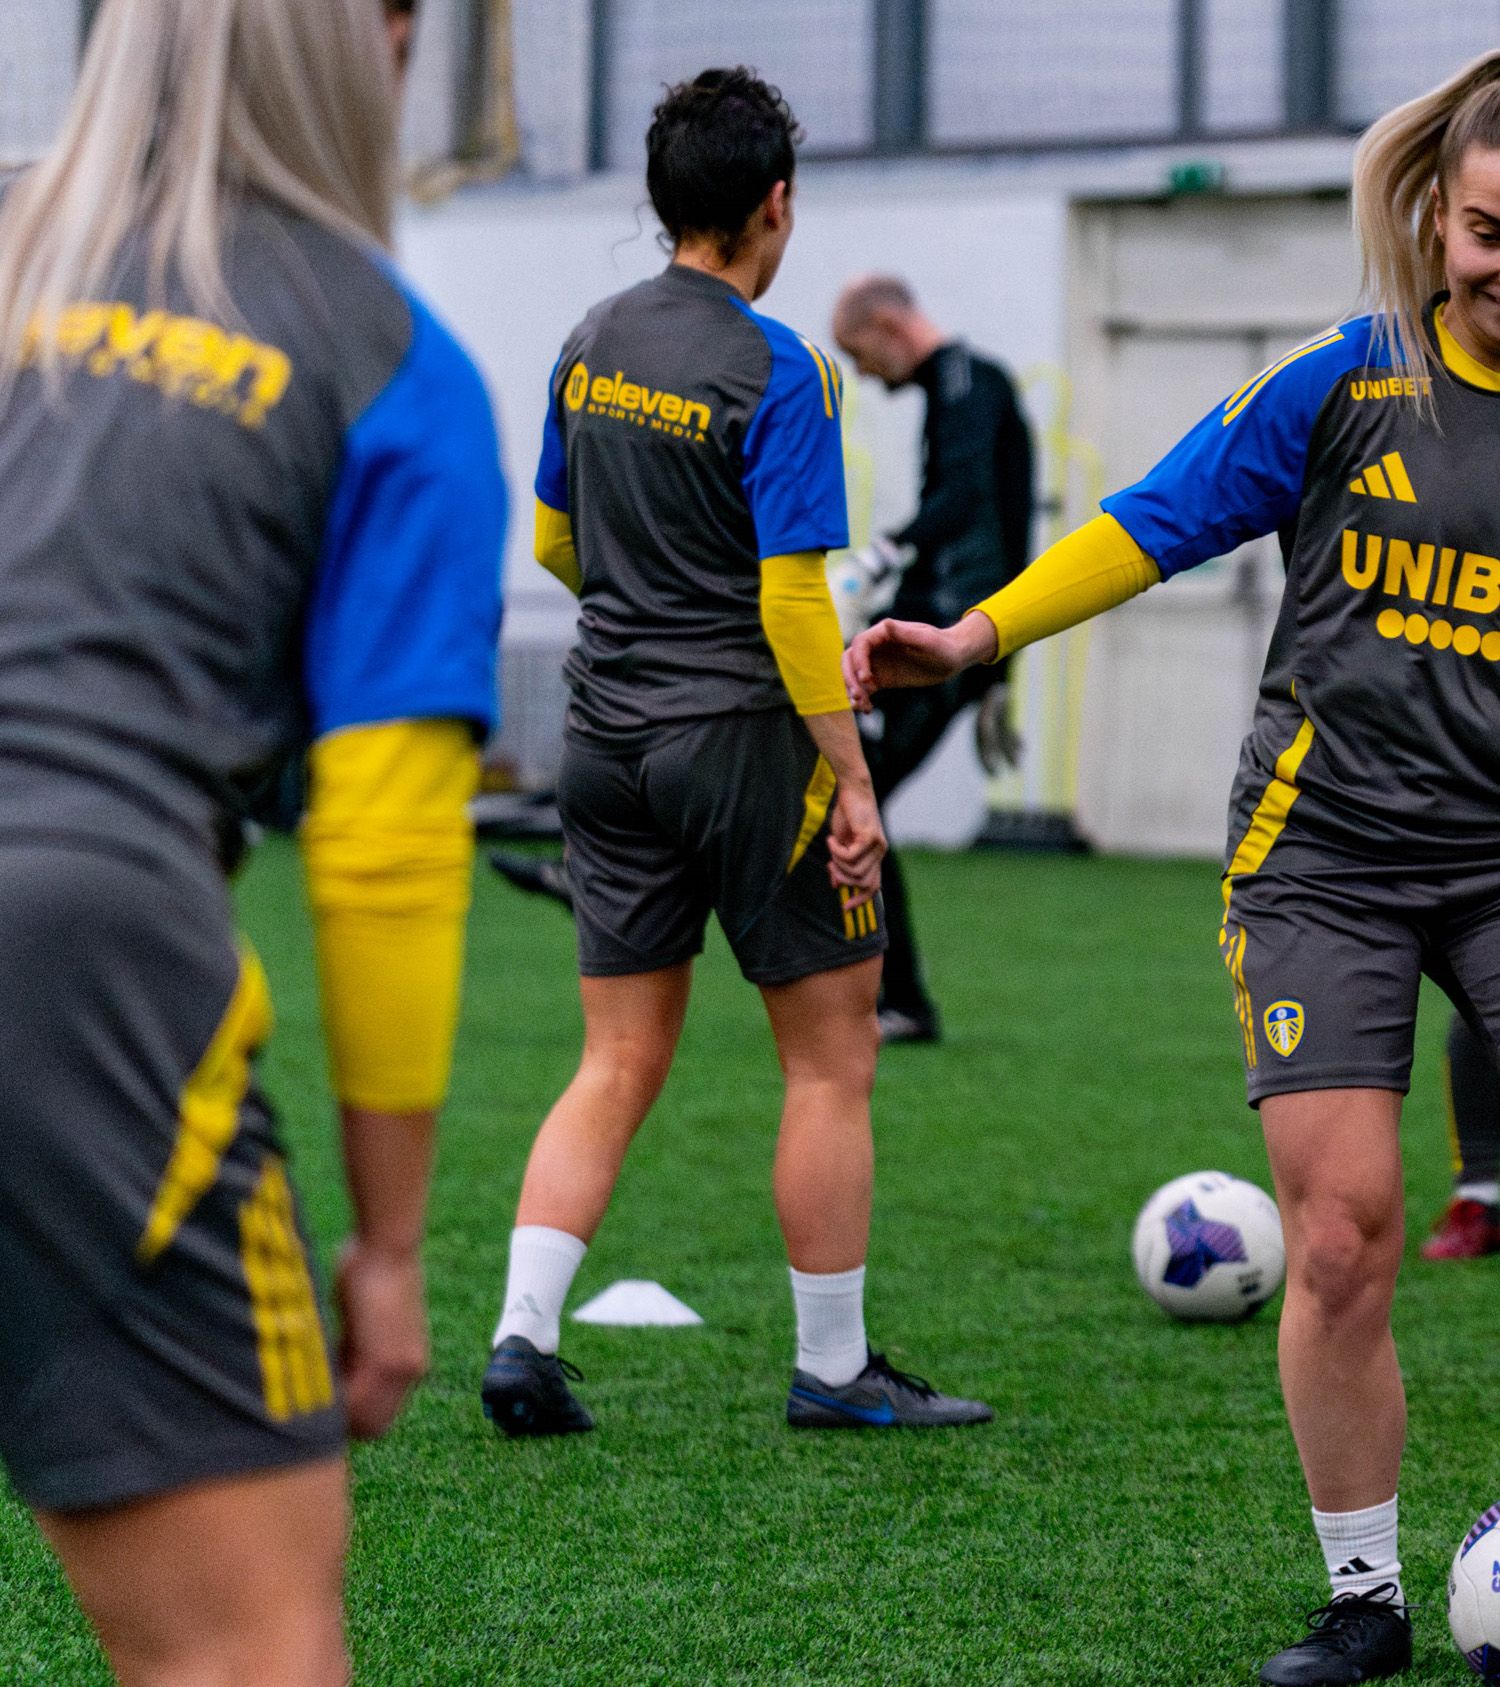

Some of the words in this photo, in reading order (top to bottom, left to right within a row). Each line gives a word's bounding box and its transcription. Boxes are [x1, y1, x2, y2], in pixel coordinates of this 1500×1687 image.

[590, 370, 711, 431] eleven
[1350, 377, 1433, 401] UNIBET
[587, 402, 646, 427] SPORTS
[651, 418, 705, 442] MEDIA
